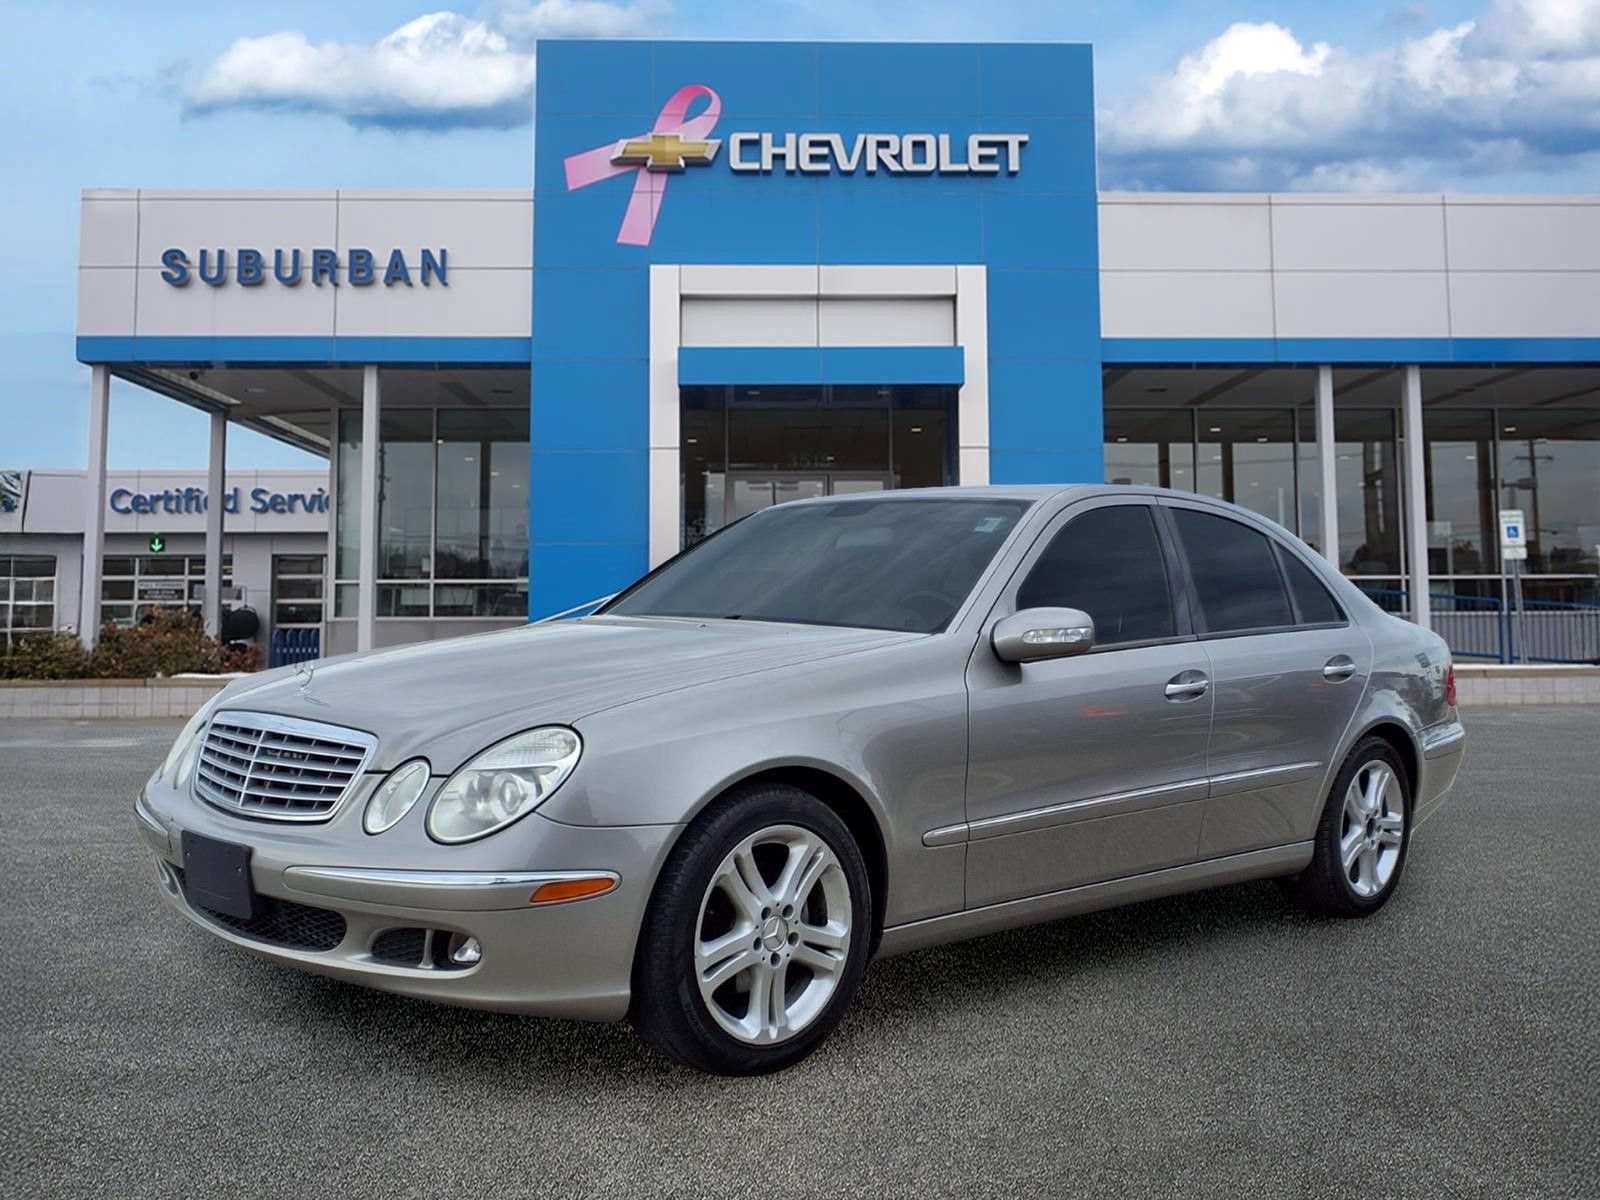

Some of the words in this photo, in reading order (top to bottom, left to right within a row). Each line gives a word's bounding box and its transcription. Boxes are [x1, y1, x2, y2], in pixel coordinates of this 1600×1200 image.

[729, 132, 1029, 173] CHEVROLET
[161, 248, 449, 286] SUBURBAN
[110, 487, 240, 514] Certifid
